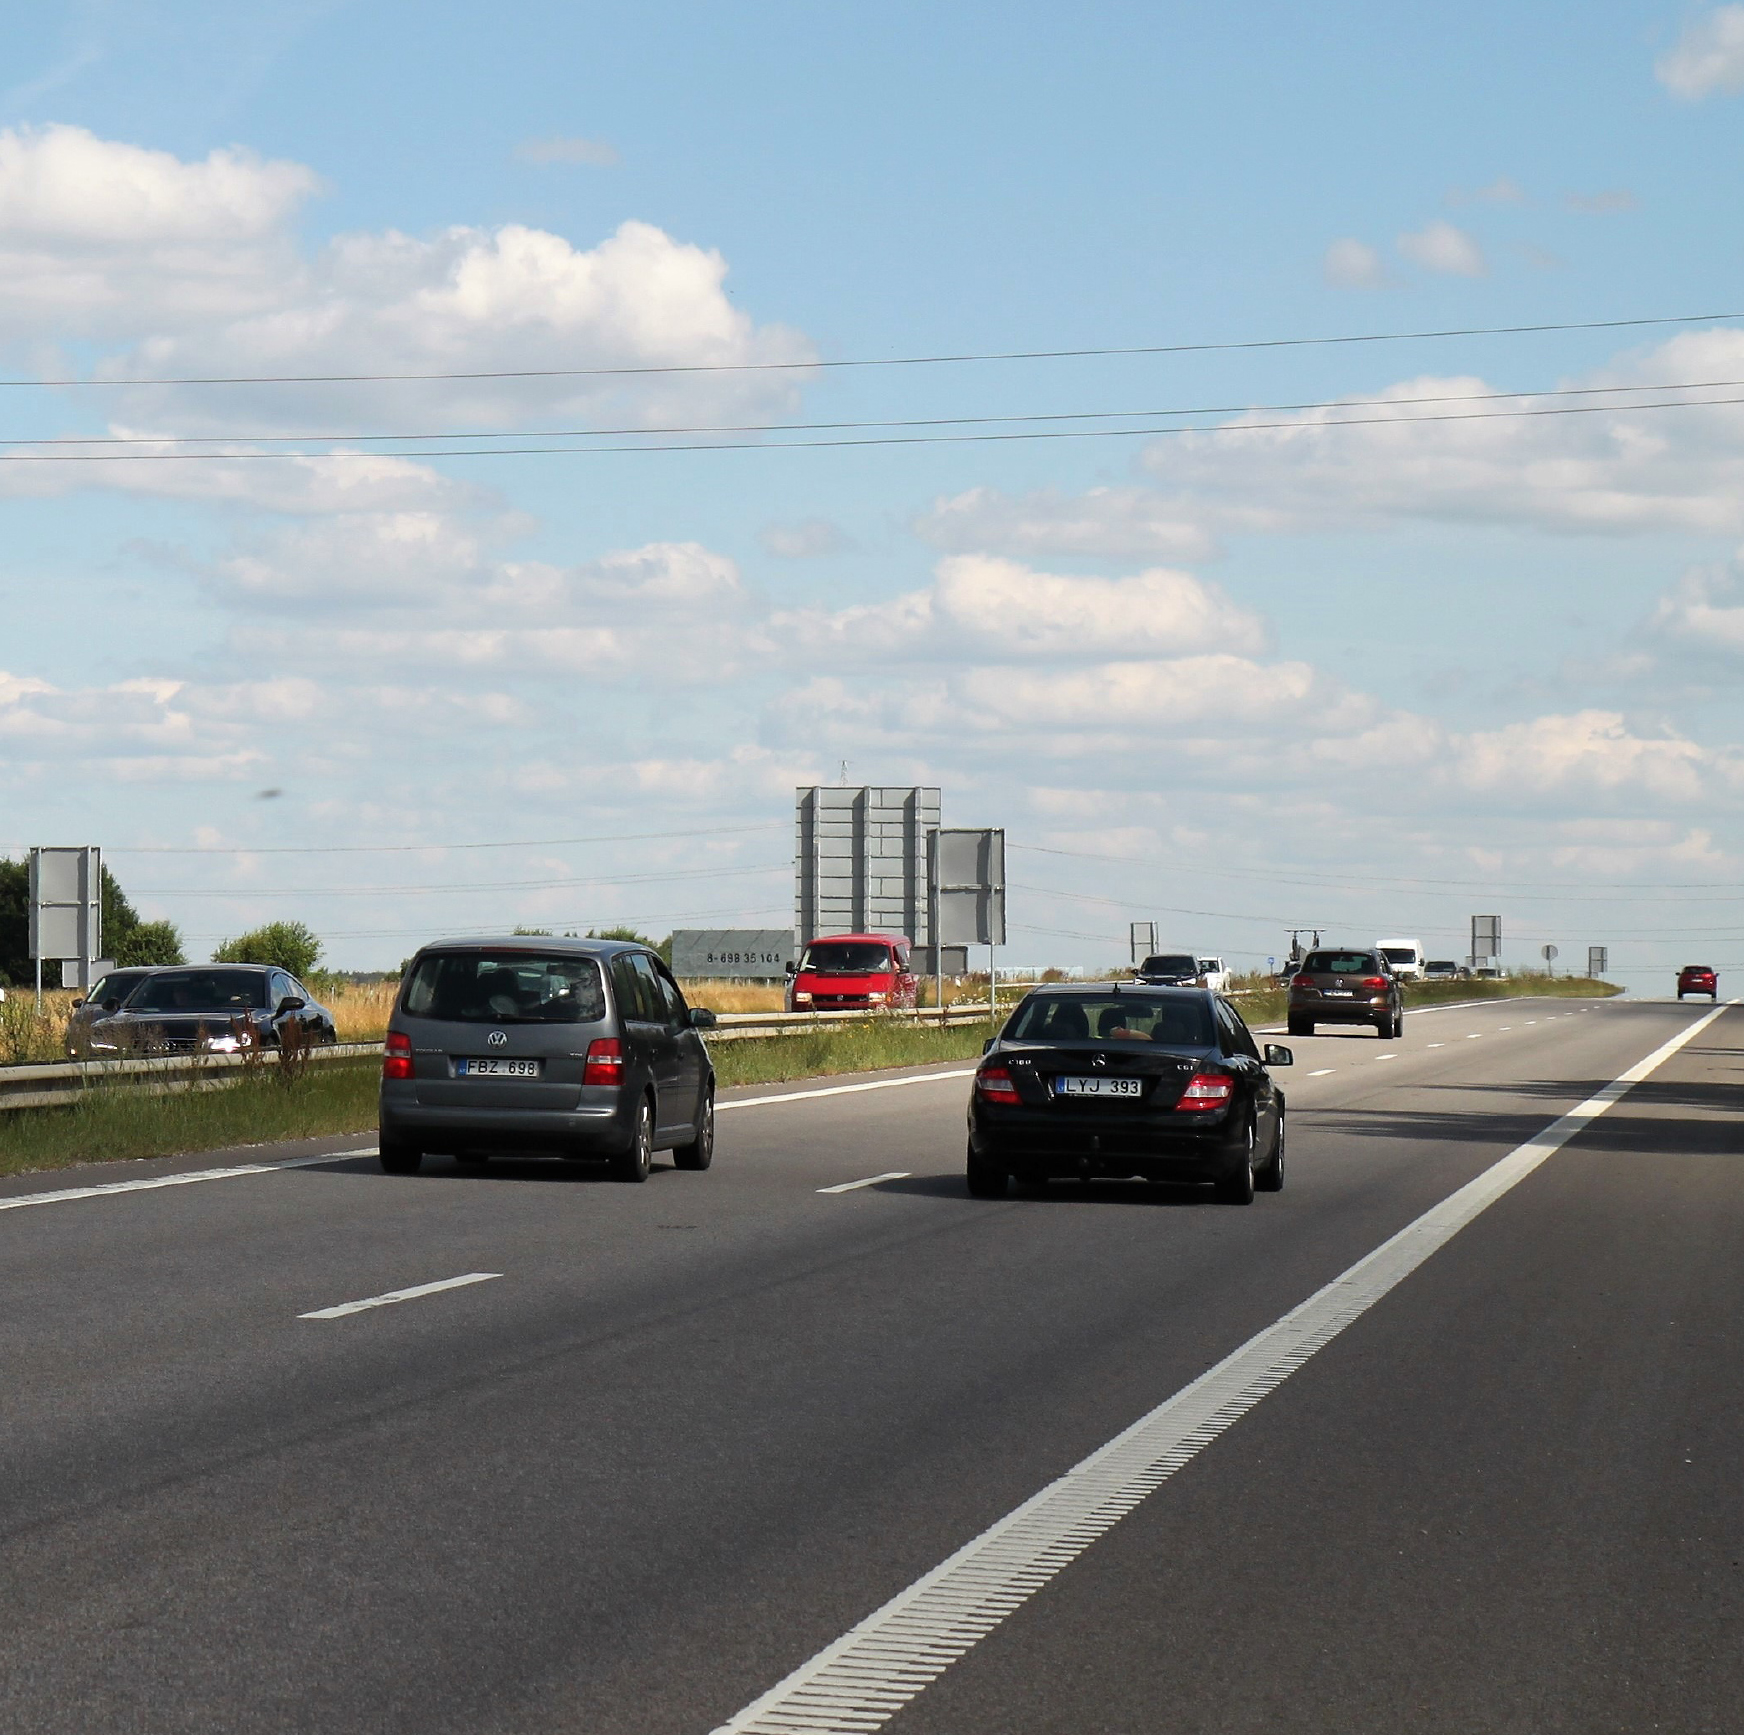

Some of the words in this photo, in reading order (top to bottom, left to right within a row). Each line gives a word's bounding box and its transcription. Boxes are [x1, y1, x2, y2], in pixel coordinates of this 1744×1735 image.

[707, 953, 740, 963] 8-698
[744, 953, 756, 963] 35
[761, 953, 780, 963] 104
[468, 1061, 498, 1073] FBZ
[508, 1061, 535, 1075] 698
[1066, 1079, 1100, 1092] LYJ
[1110, 1080, 1138, 1094] 393
